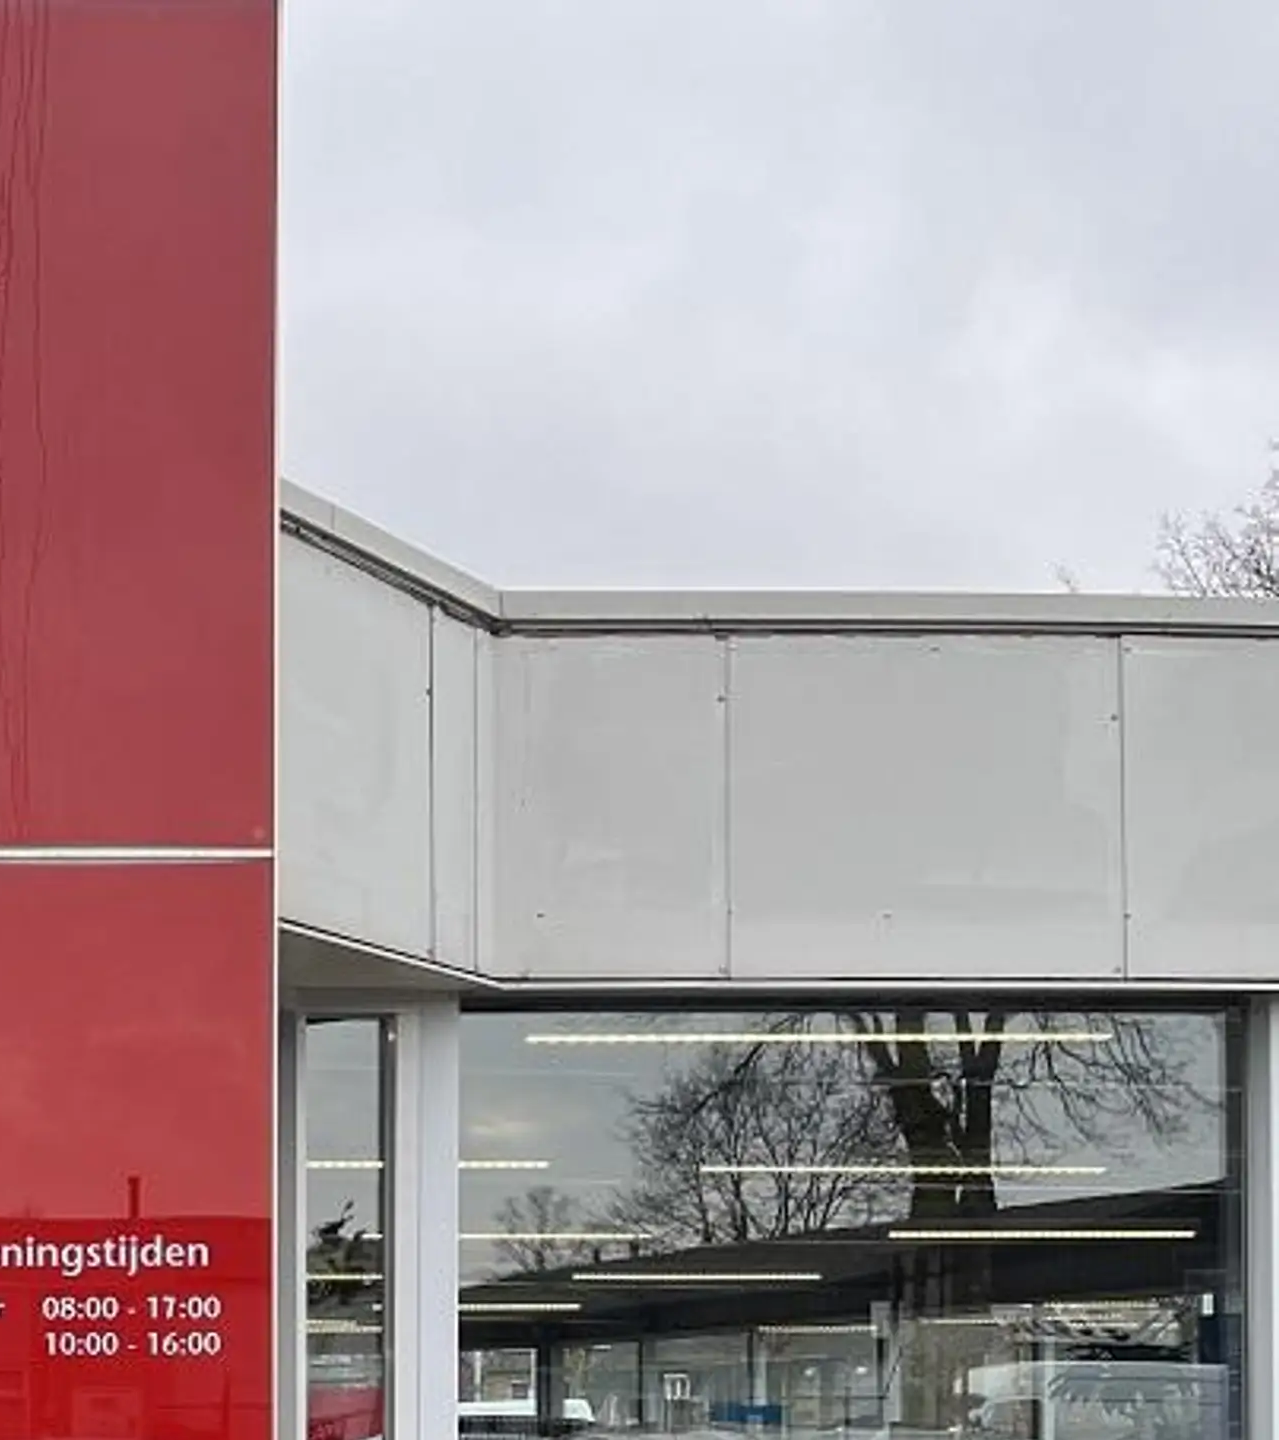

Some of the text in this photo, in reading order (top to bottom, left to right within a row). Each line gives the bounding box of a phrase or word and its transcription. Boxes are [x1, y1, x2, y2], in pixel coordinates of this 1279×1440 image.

[42, 1296, 118, 1320] 08:00
[147, 1296, 221, 1319] 17:00
[45, 1332, 118, 1356] 10:00
[147, 1332, 221, 1356] 16:00
